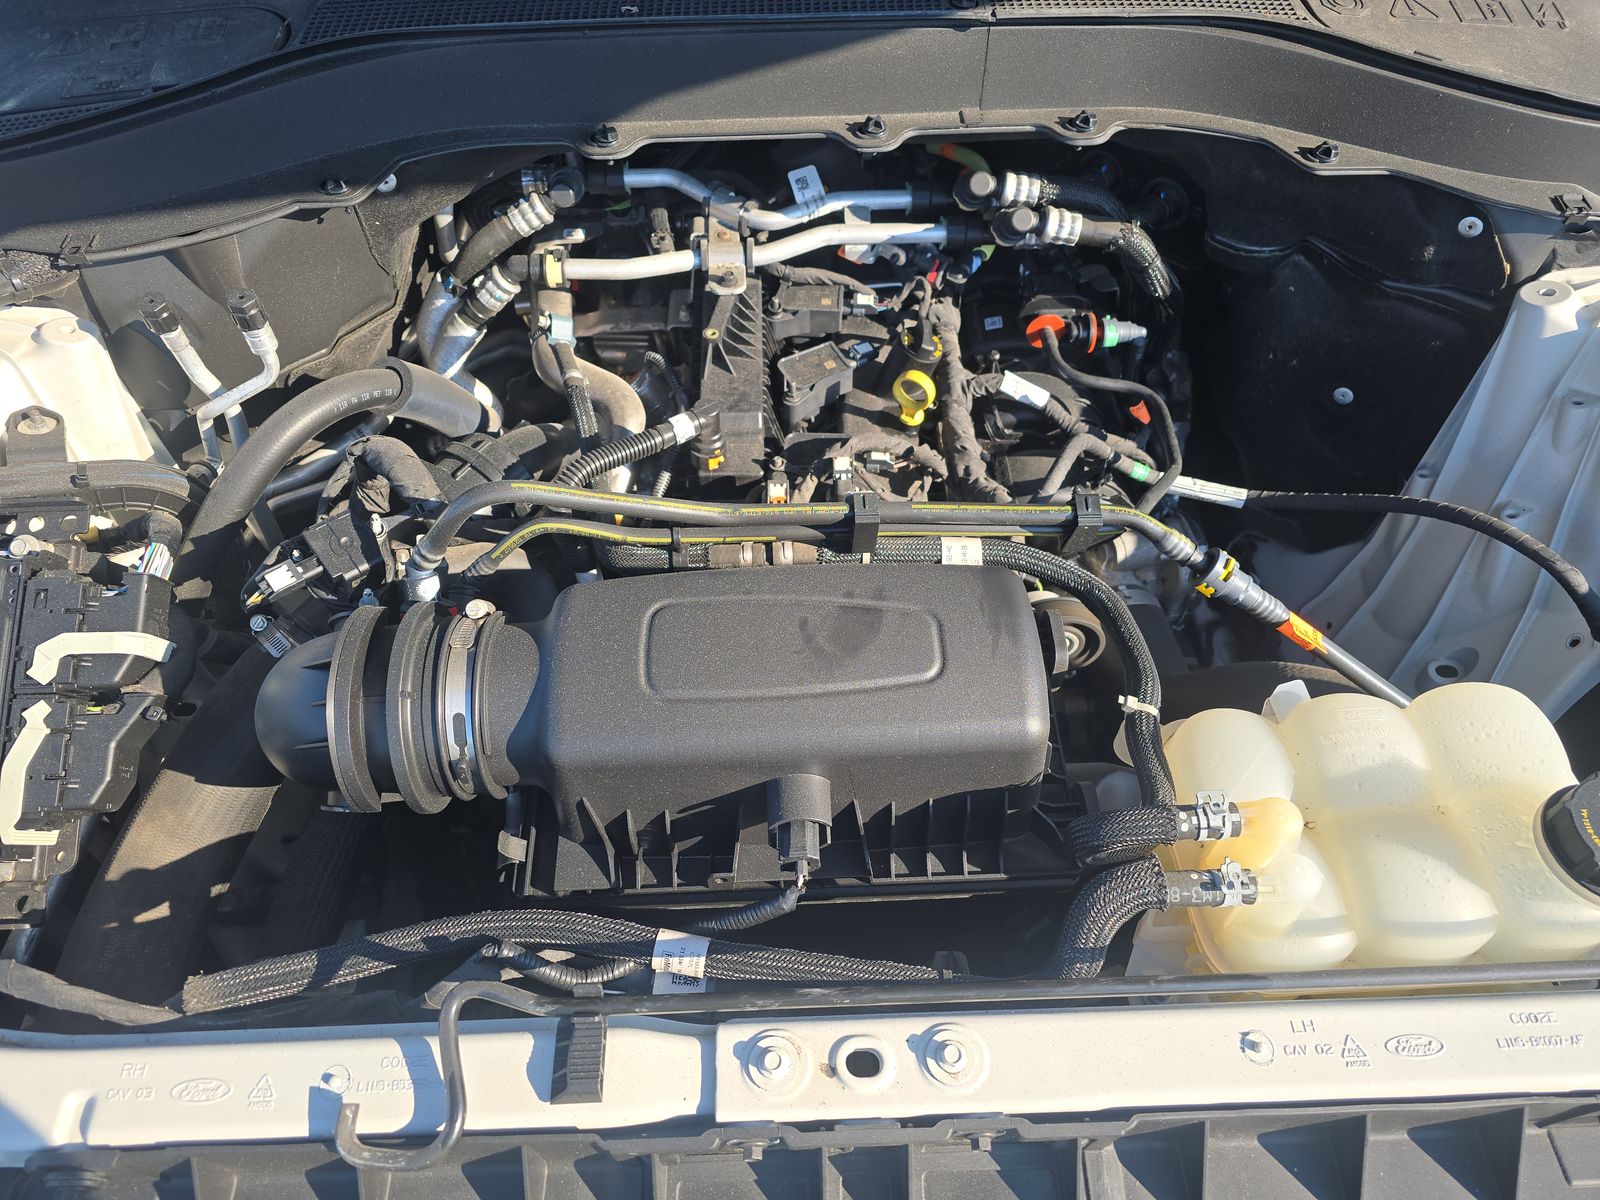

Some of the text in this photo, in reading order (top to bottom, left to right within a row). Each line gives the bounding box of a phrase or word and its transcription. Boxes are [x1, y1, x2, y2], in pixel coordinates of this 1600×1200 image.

[1289, 1019, 1316, 1034] LH
[1314, 1043, 1335, 1055] 02
[1393, 1036, 1438, 1056] Ford
[121, 1062, 149, 1080] RH
[178, 1079, 224, 1101] Ford
